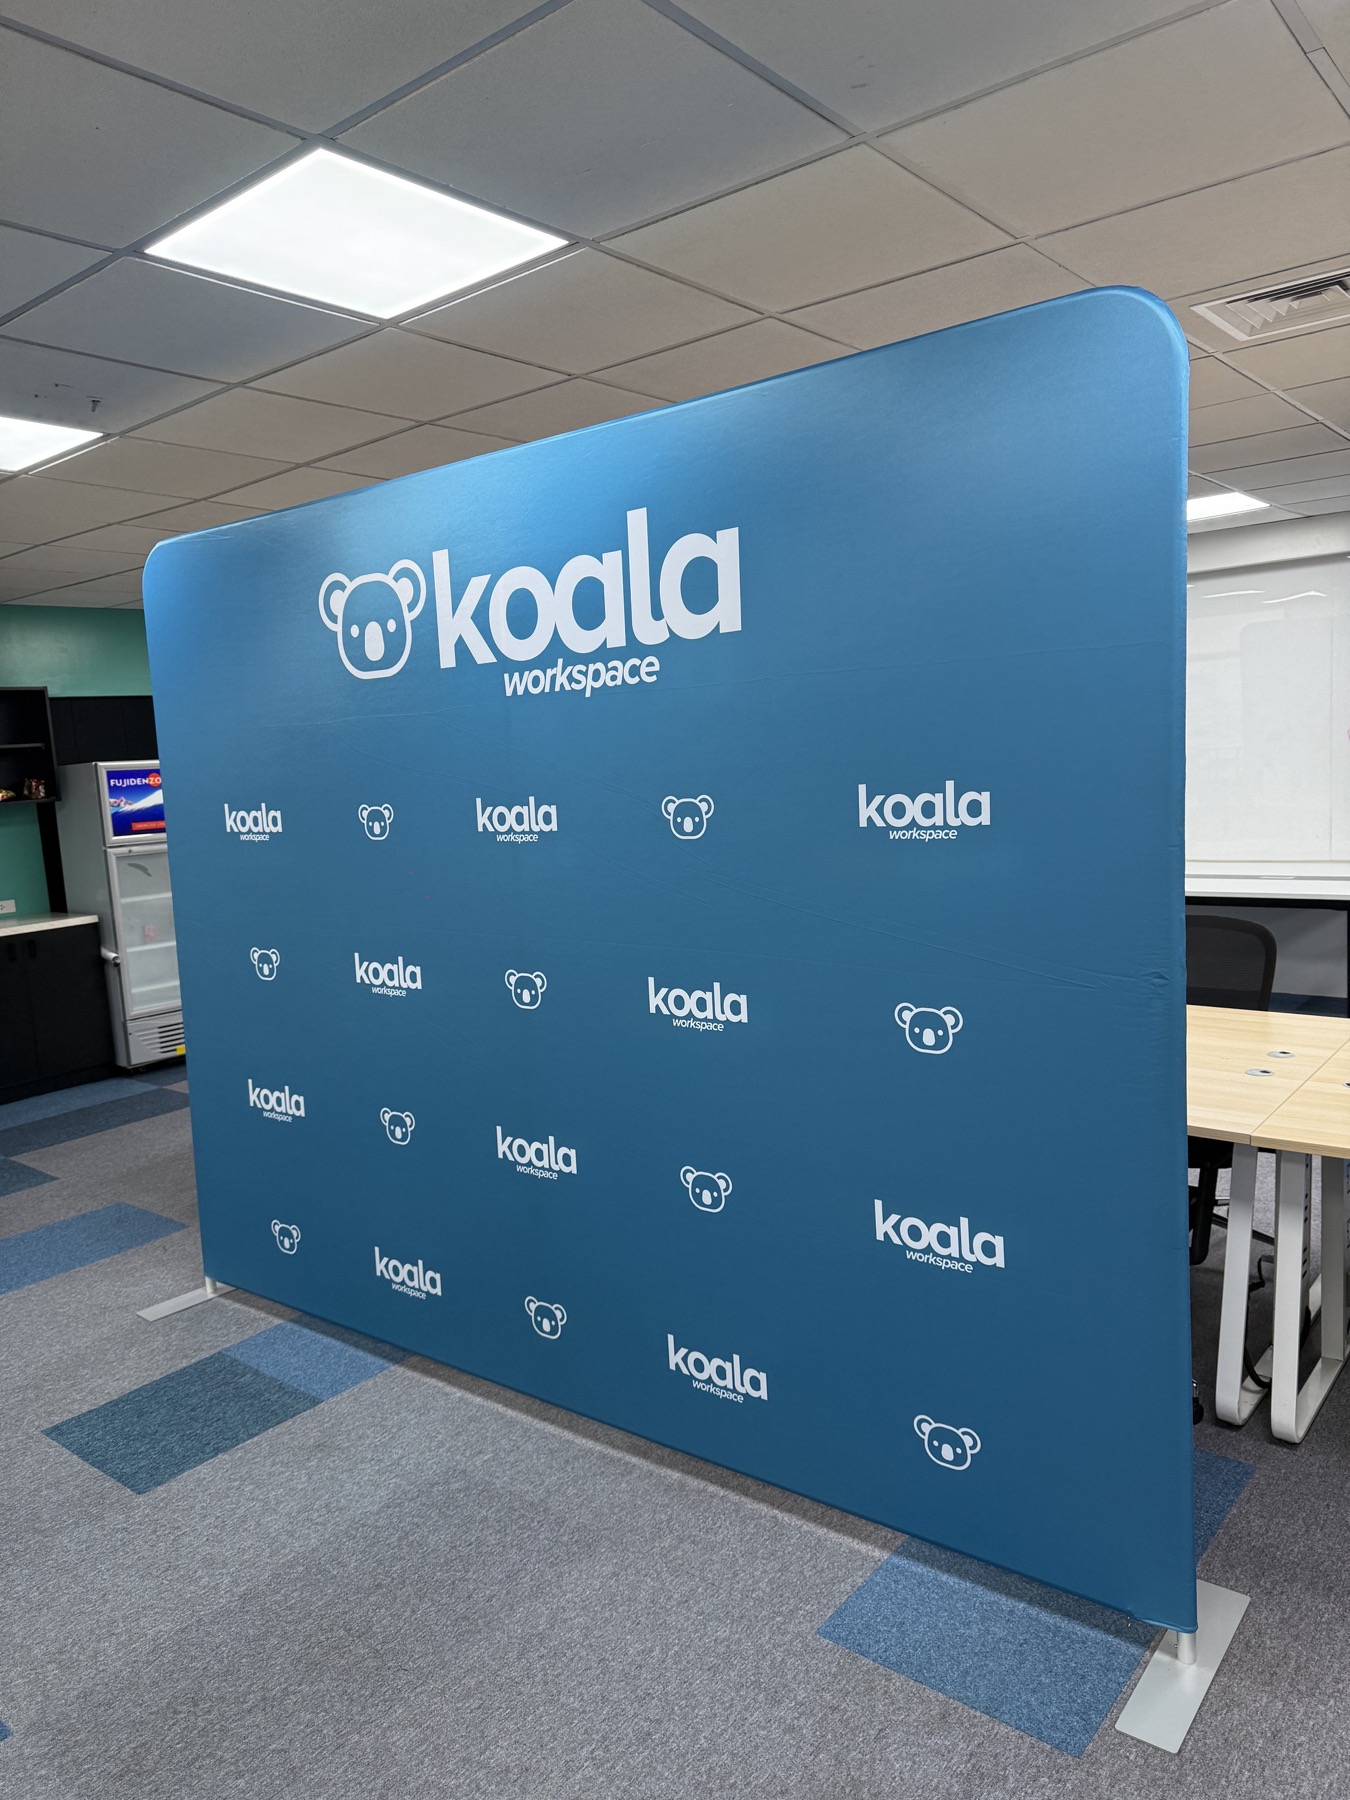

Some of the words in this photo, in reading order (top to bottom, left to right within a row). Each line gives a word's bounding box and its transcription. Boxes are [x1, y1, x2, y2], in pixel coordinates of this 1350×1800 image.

[432, 507, 742, 669] koala
[504, 656, 661, 698] workspace
[110, 777, 162, 787] FUJIDENZO
[224, 803, 282, 833] koala
[476, 796, 557, 835] koala
[858, 780, 990, 828] koala
[239, 831, 270, 842] workspace
[495, 832, 539, 844] workspace
[889, 827, 957, 842] workspace
[354, 952, 422, 990] koala
[371, 986, 407, 997] workspace
[648, 976, 748, 1024] koala
[672, 1018, 725, 1032] workspace
[248, 1079, 305, 1117] koala
[263, 1110, 293, 1122] workspace
[496, 1126, 577, 1175] koala
[516, 1164, 559, 1180] workspace
[874, 1199, 1005, 1268] koala
[375, 1246, 442, 1297] koala
[906, 1250, 973, 1273] workspace
[391, 1283, 427, 1300] workspace
[668, 1334, 768, 1401] koala
[692, 1380, 745, 1403] workspace
